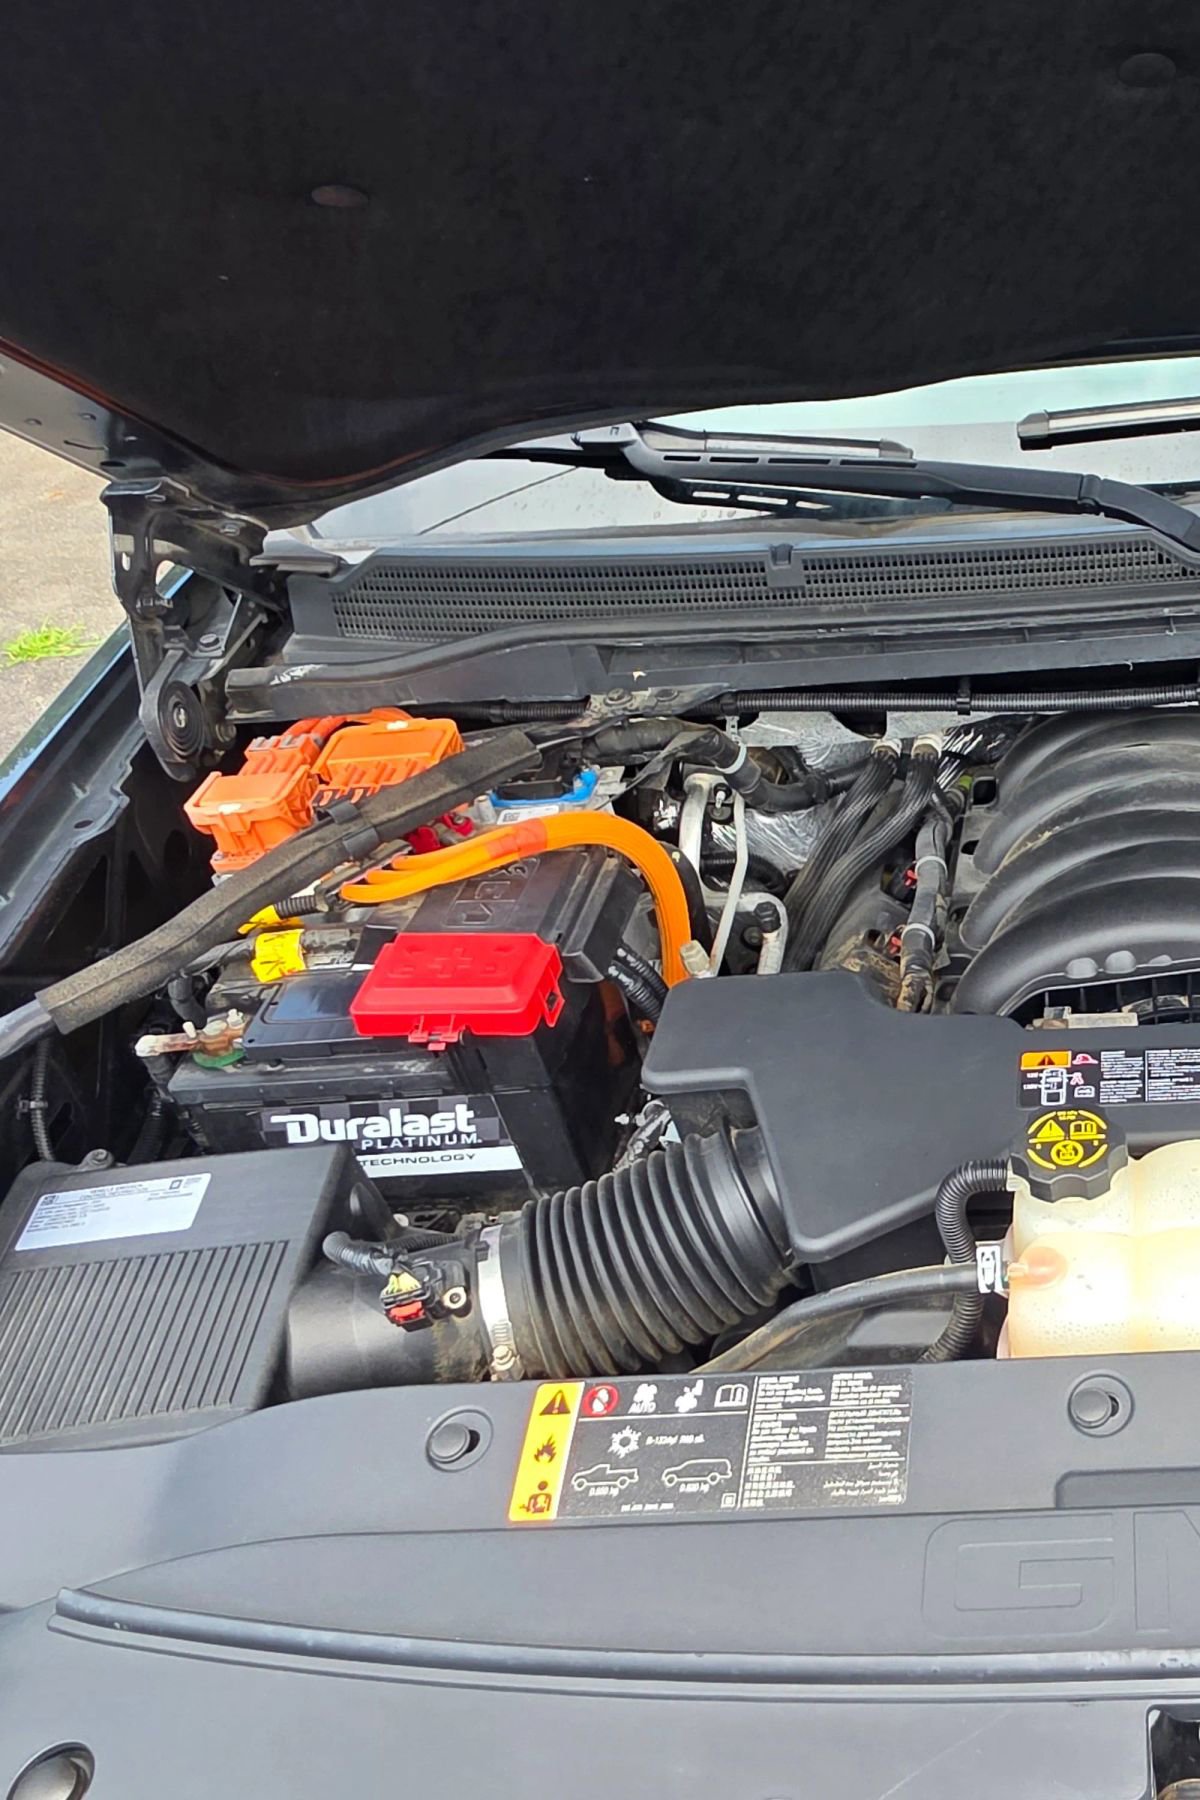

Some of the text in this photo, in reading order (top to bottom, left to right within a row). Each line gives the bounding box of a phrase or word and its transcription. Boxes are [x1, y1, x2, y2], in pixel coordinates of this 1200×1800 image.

[270, 1104, 477, 1144] Duralast
[361, 1132, 478, 1151] PLATINUM
[360, 1153, 477, 1168] TECHNOLOGY
